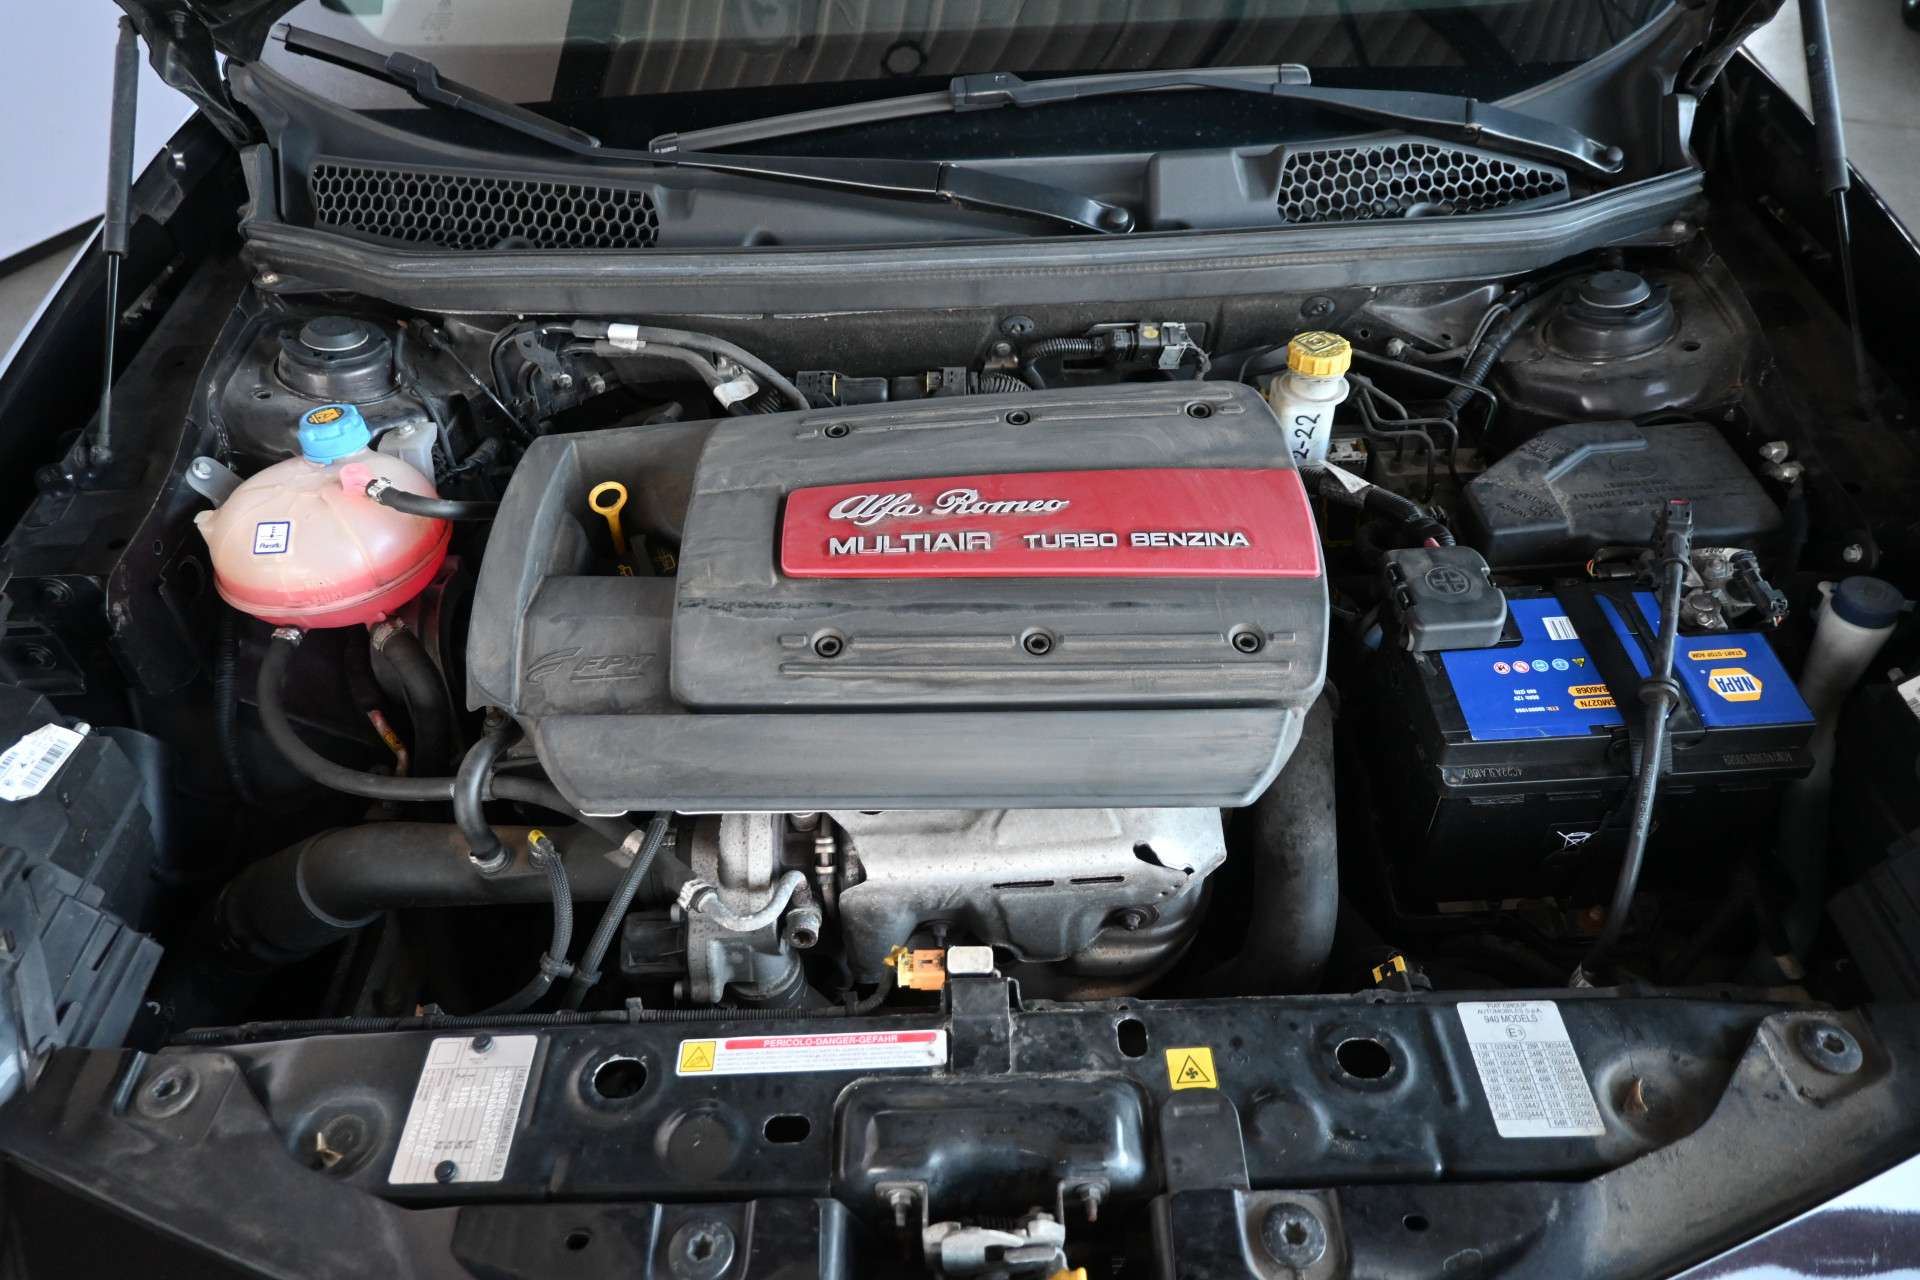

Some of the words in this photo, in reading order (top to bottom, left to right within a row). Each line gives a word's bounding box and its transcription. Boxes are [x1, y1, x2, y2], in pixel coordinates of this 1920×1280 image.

[828, 493, 922, 526] Alfa
[934, 488, 1070, 518] Romeo
[828, 532, 992, 557] MULTIAIR
[1023, 532, 1118, 550] TURBO
[1130, 530, 1250, 549] BENZINA
[1692, 651, 1706, 659] AGM
[1707, 649, 1744, 658] START-STOP
[1714, 676, 1757, 693] NAPA
[1483, 1015, 1499, 1023] 940
[1500, 1014, 1538, 1022] MODELS
[763, 1034, 899, 1048] PERICOLO-DANGER-GEFAHR
[517, 1069, 526, 1080] FIAT
[511, 1084, 522, 1105] GROUP
[499, 1107, 515, 1153] AUTOMOBILES
